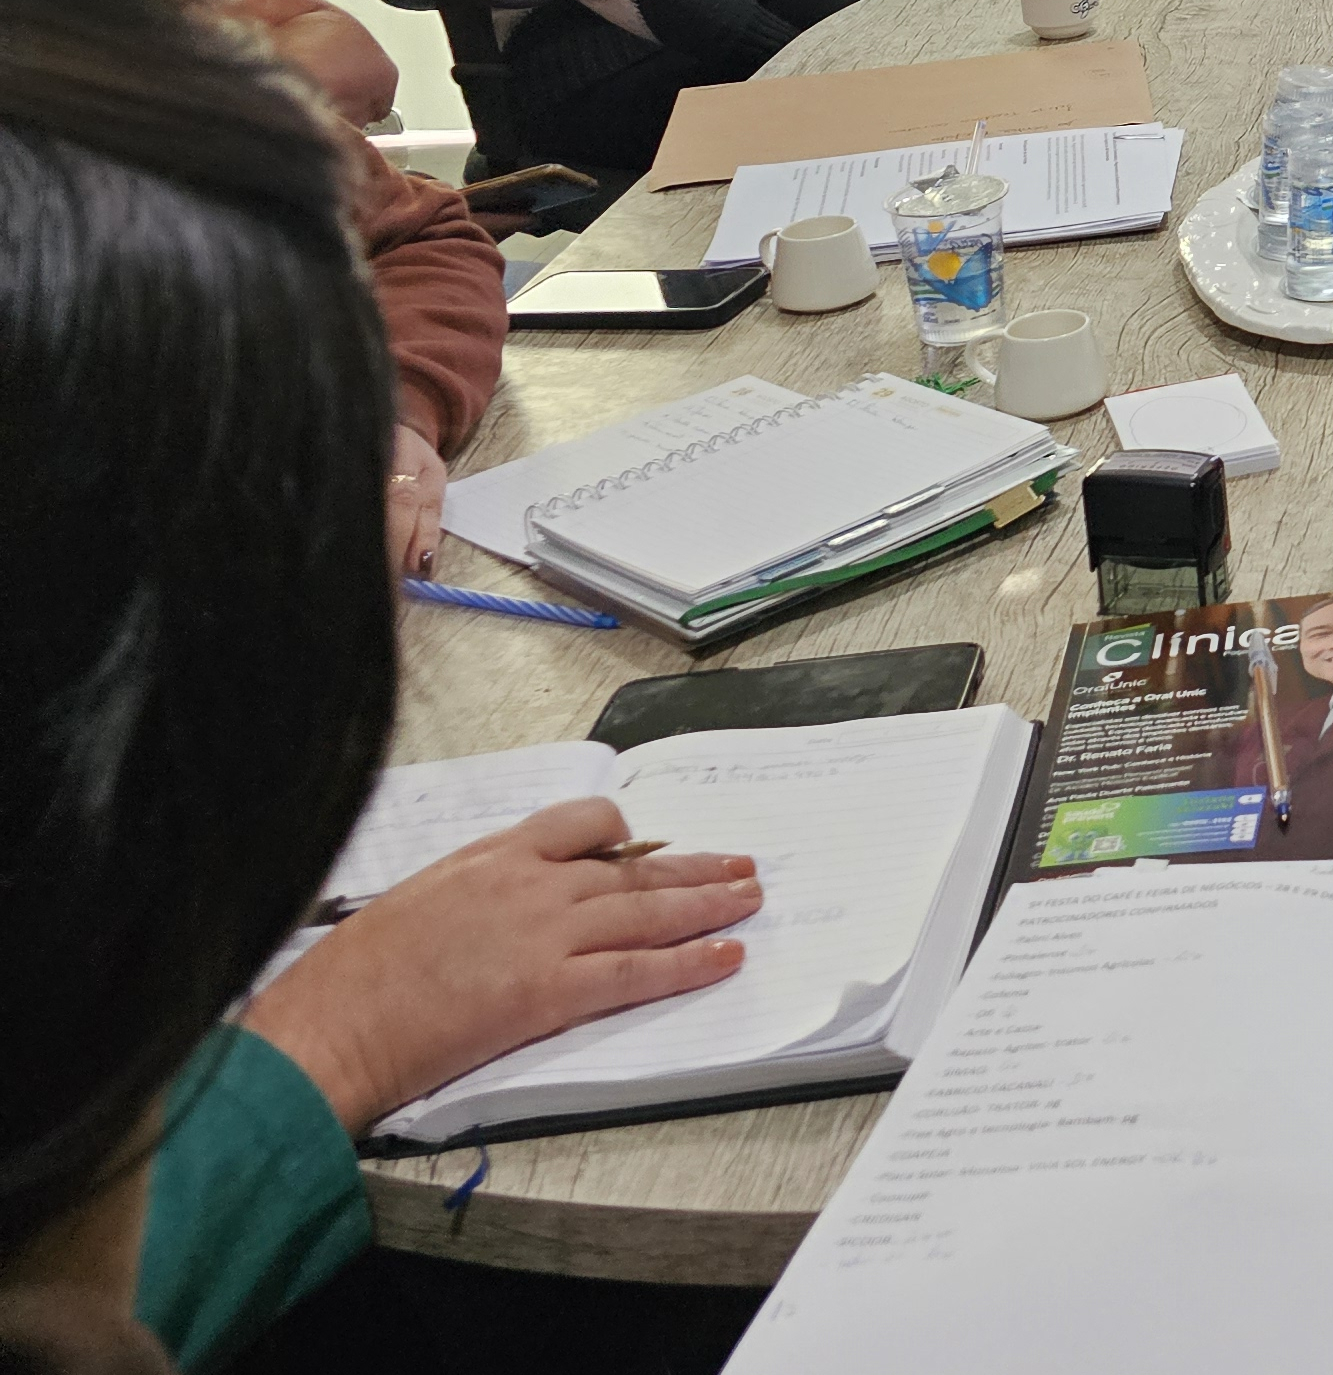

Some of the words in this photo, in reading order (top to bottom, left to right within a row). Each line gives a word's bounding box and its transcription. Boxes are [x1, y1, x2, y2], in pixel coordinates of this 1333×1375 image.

[1096, 624, 1300, 667] Clínica
[1045, 897, 1079, 907] FESTA
[1082, 894, 1101, 904] DO
[1102, 889, 1134, 902] CAFÉ
[1145, 887, 1178, 897] FEIRA
[1181, 885, 1197, 894] DE
[1200, 880, 1262, 892] NEGÓCIOS
